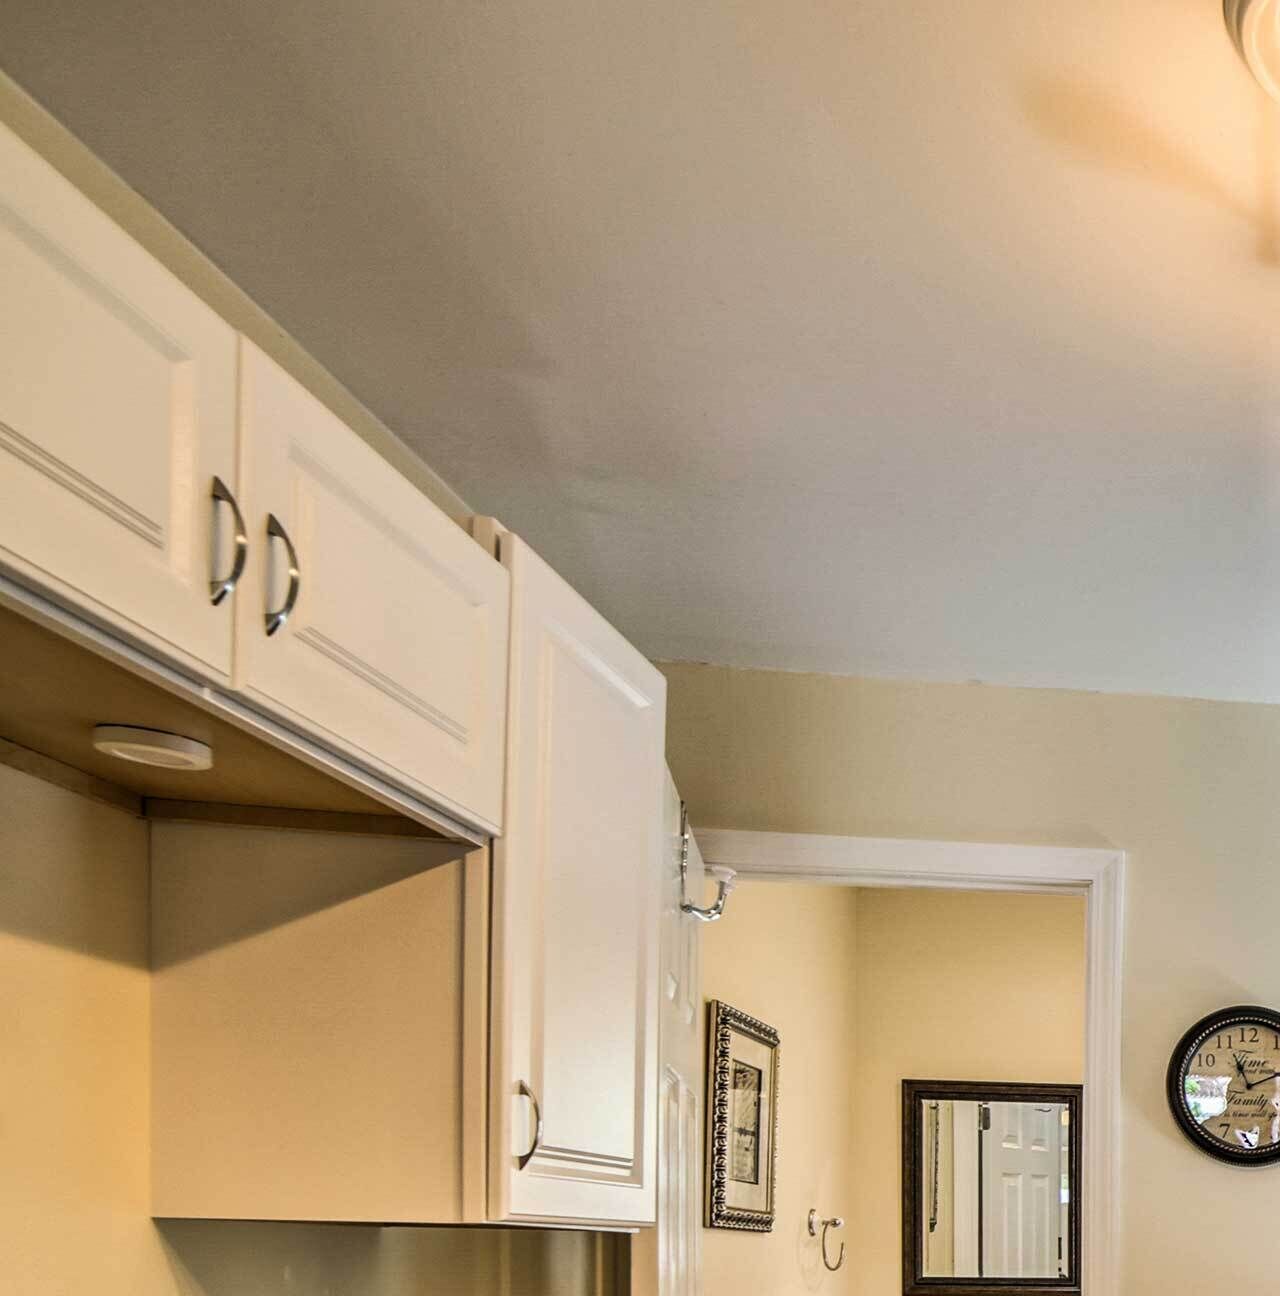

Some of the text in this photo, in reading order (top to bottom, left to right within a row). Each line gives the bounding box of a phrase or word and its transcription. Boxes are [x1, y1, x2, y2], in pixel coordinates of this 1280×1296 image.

[1216, 1034, 1233, 1049] 11
[1239, 1027, 1259, 1043] 12
[1273, 1035, 1280, 1050] 1
[1198, 1053, 1216, 1067] 10
[1226, 1089, 1269, 1112] Family
[1219, 1123, 1231, 1139] 7
